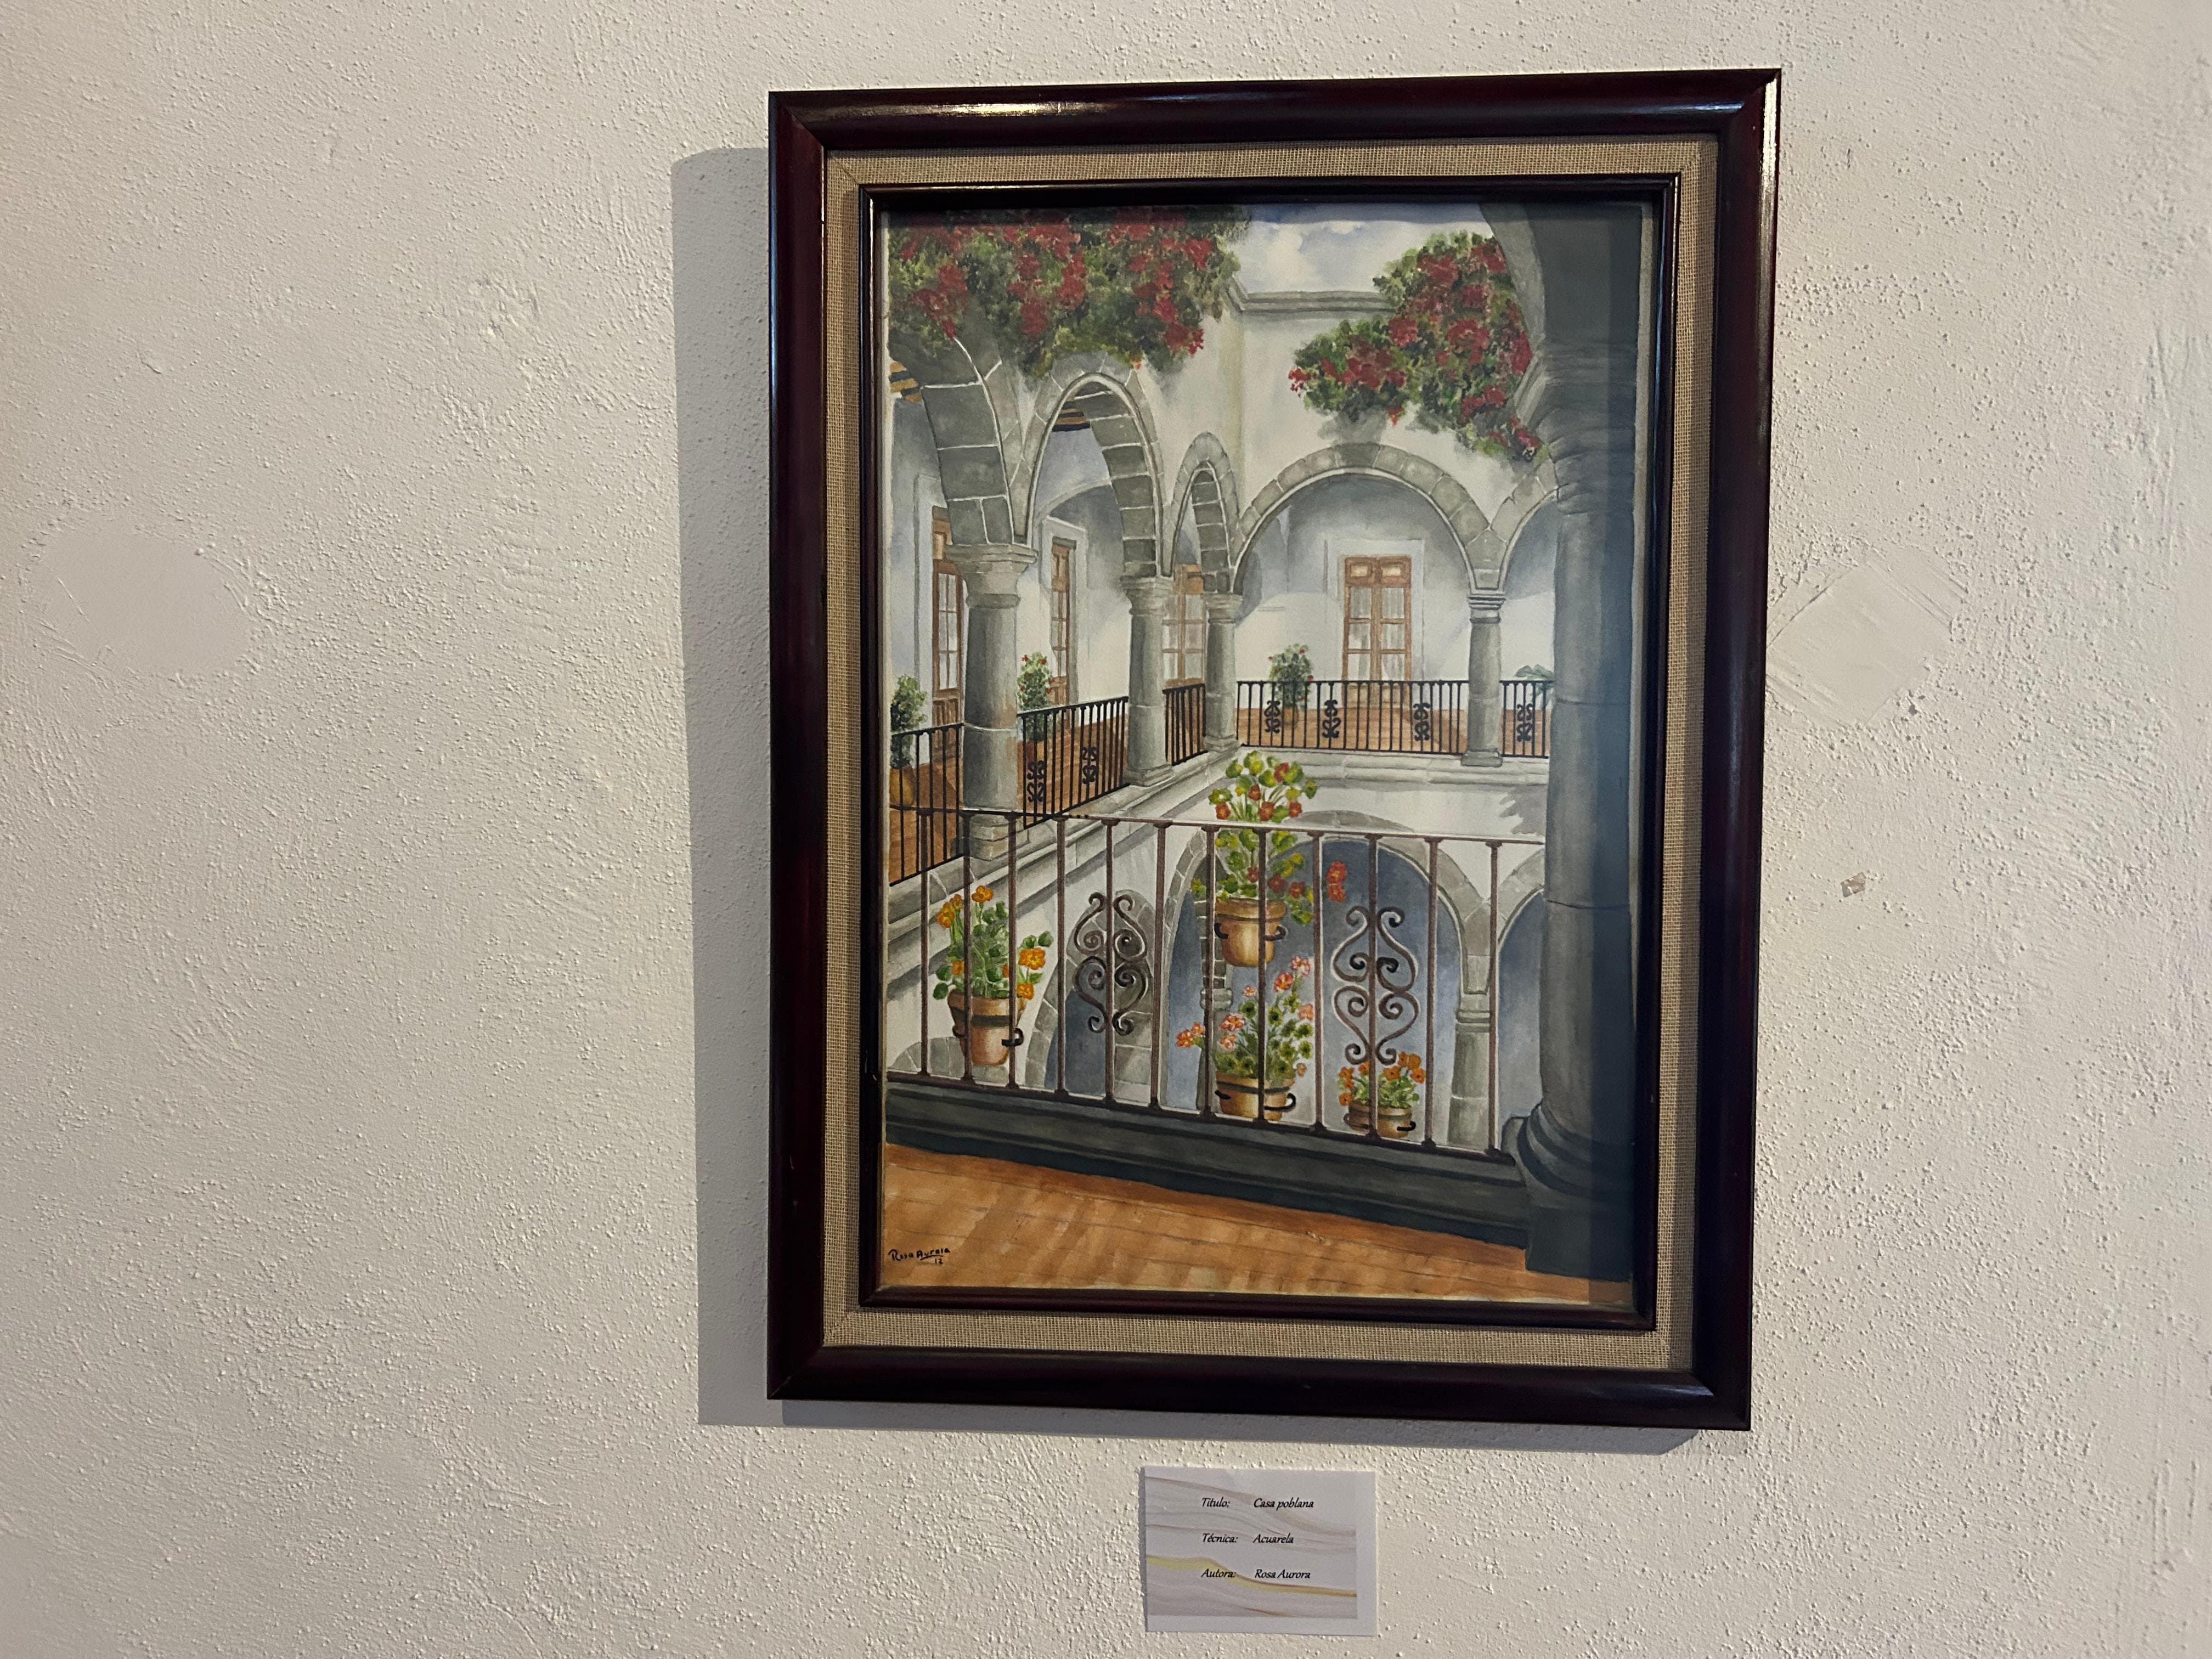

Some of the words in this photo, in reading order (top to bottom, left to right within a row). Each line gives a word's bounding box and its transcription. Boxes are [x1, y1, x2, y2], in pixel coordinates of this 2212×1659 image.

[1254, 1498, 1274, 1508] Casa
[1276, 1497, 1314, 1510] poblana
[1202, 1533, 1238, 1543] Técnica:
[1252, 1533, 1294, 1543] Acuarela
[1200, 1568, 1236, 1578] Autora:
[1254, 1568, 1276, 1578] Rosa
[1277, 1569, 1311, 1578] Aurora
